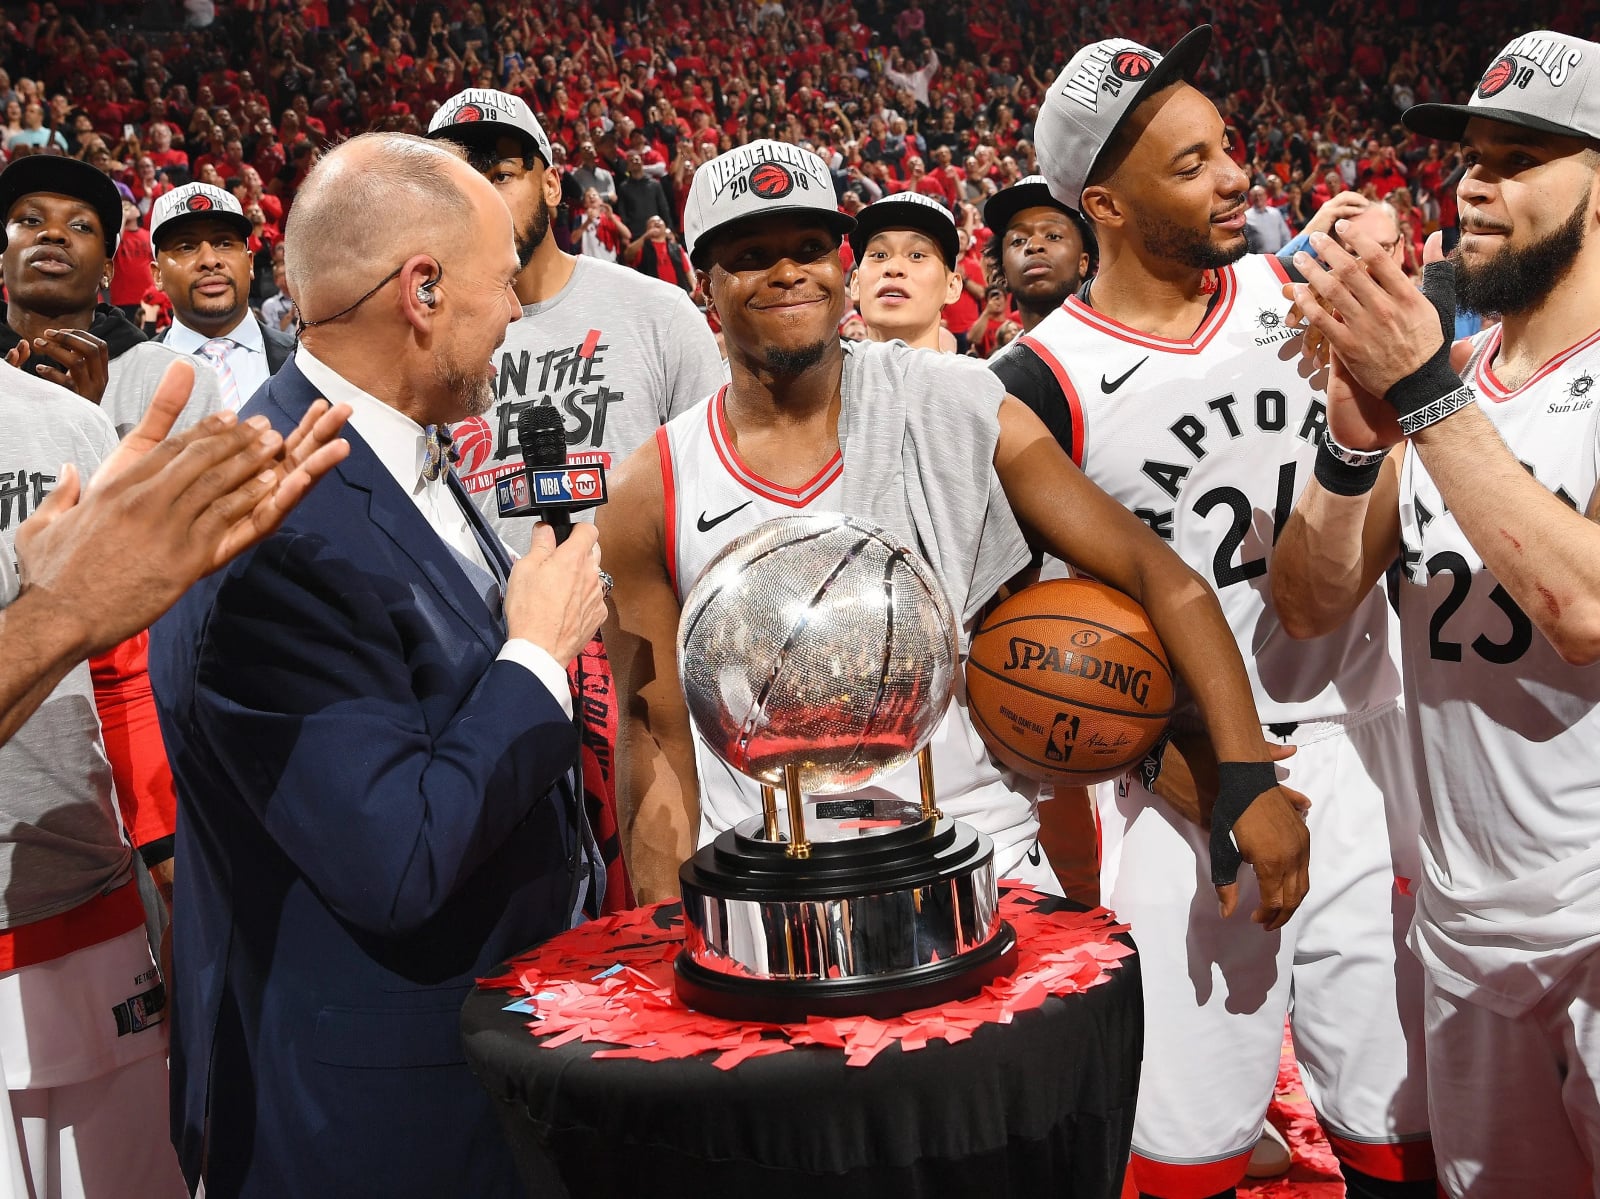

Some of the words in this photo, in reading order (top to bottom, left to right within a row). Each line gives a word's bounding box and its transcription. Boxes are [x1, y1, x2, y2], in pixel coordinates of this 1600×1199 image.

[1062, 57, 1107, 114] NBA
[1102, 74, 1124, 98] 20
[1513, 65, 1534, 89] 19
[455, 90, 517, 118] FINALS
[485, 107, 498, 120] 19
[706, 149, 750, 205] NBA
[748, 143, 827, 189] FINALS
[793, 170, 809, 190] 19
[730, 175, 748, 200] 20
[175, 201, 186, 215] 20
[1254, 335, 1278, 347] Sun
[1278, 328, 1301, 340] Life
[536, 344, 610, 393] THE
[1547, 402, 1571, 414] Sun
[1572, 399, 1594, 412] Life
[493, 386, 624, 461] EST
[1134, 388, 1327, 542] RAPTOR
[477, 472, 494, 488] NBA
[540, 478, 561, 496] NBA
[575, 480, 597, 490] TNT
[1004, 637, 1152, 708] SPALDING
